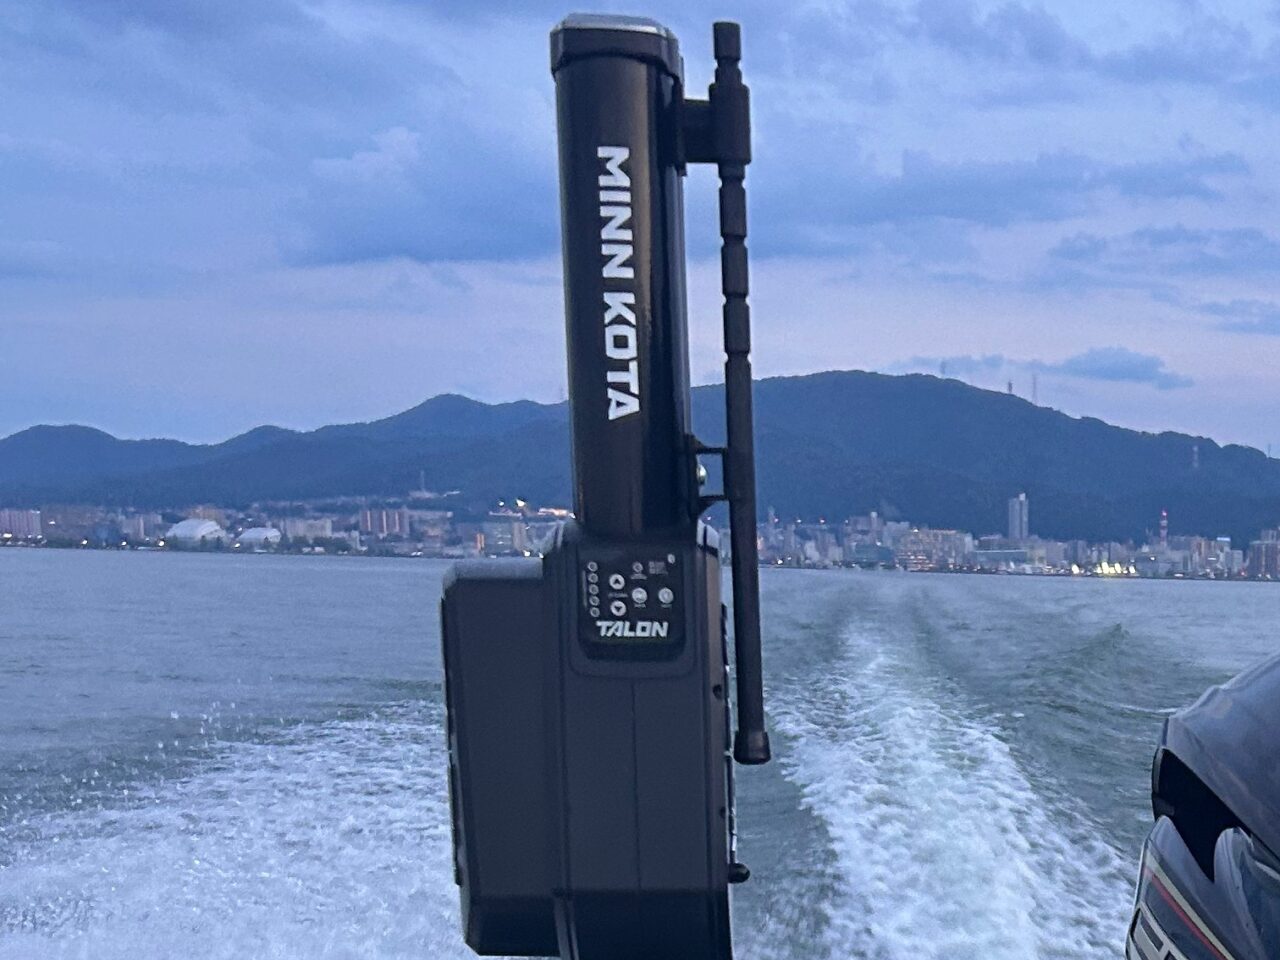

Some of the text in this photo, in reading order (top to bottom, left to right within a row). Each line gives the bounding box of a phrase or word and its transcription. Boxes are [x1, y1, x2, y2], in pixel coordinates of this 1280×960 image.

[597, 146, 641, 420] MINN KOTA
[596, 620, 669, 637] TALON
